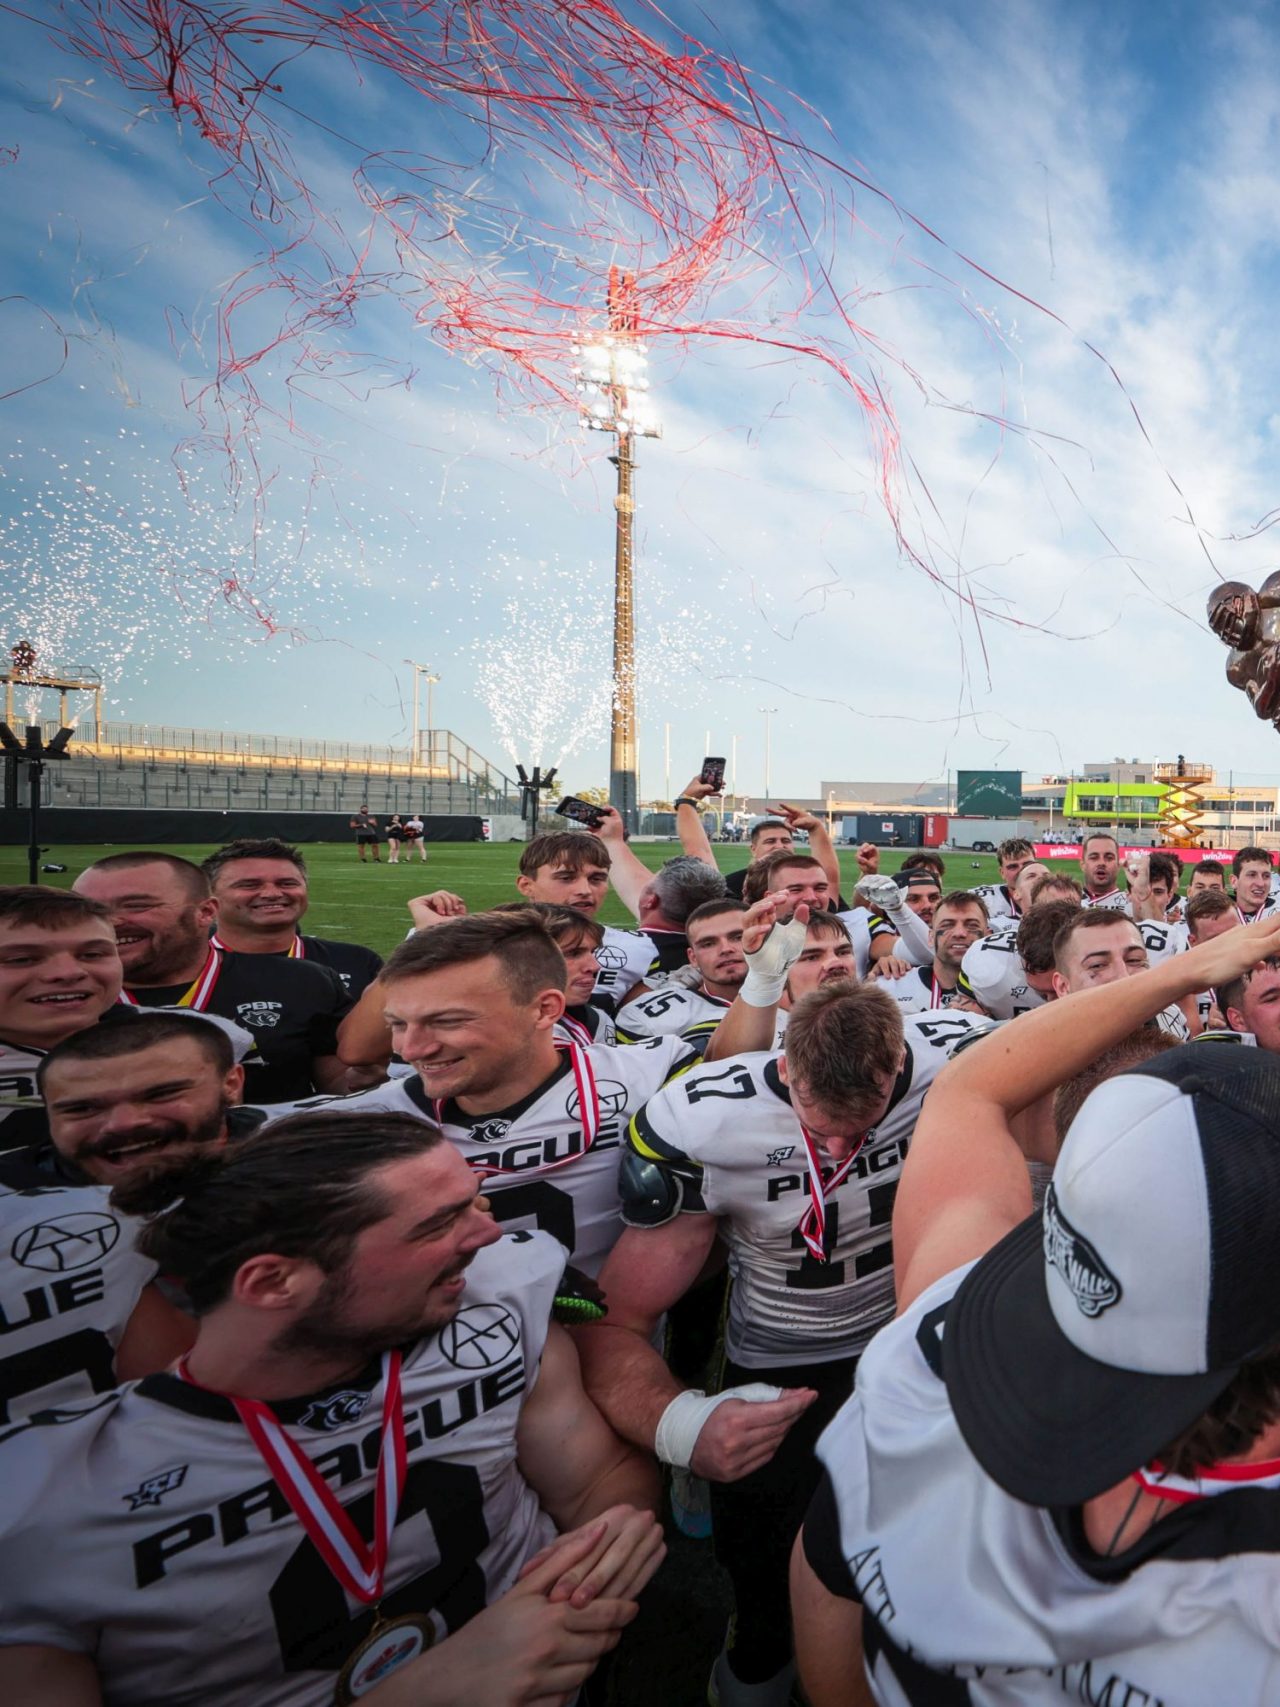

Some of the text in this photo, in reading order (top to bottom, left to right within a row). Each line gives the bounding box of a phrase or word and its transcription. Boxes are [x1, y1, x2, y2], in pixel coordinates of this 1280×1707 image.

[1050, 847, 1078, 857] win2day
[1202, 852, 1232, 862] win2day
[236, 1001, 283, 1014] PBP
[635, 990, 687, 1018] 15
[685, 1064, 757, 1104] 17
